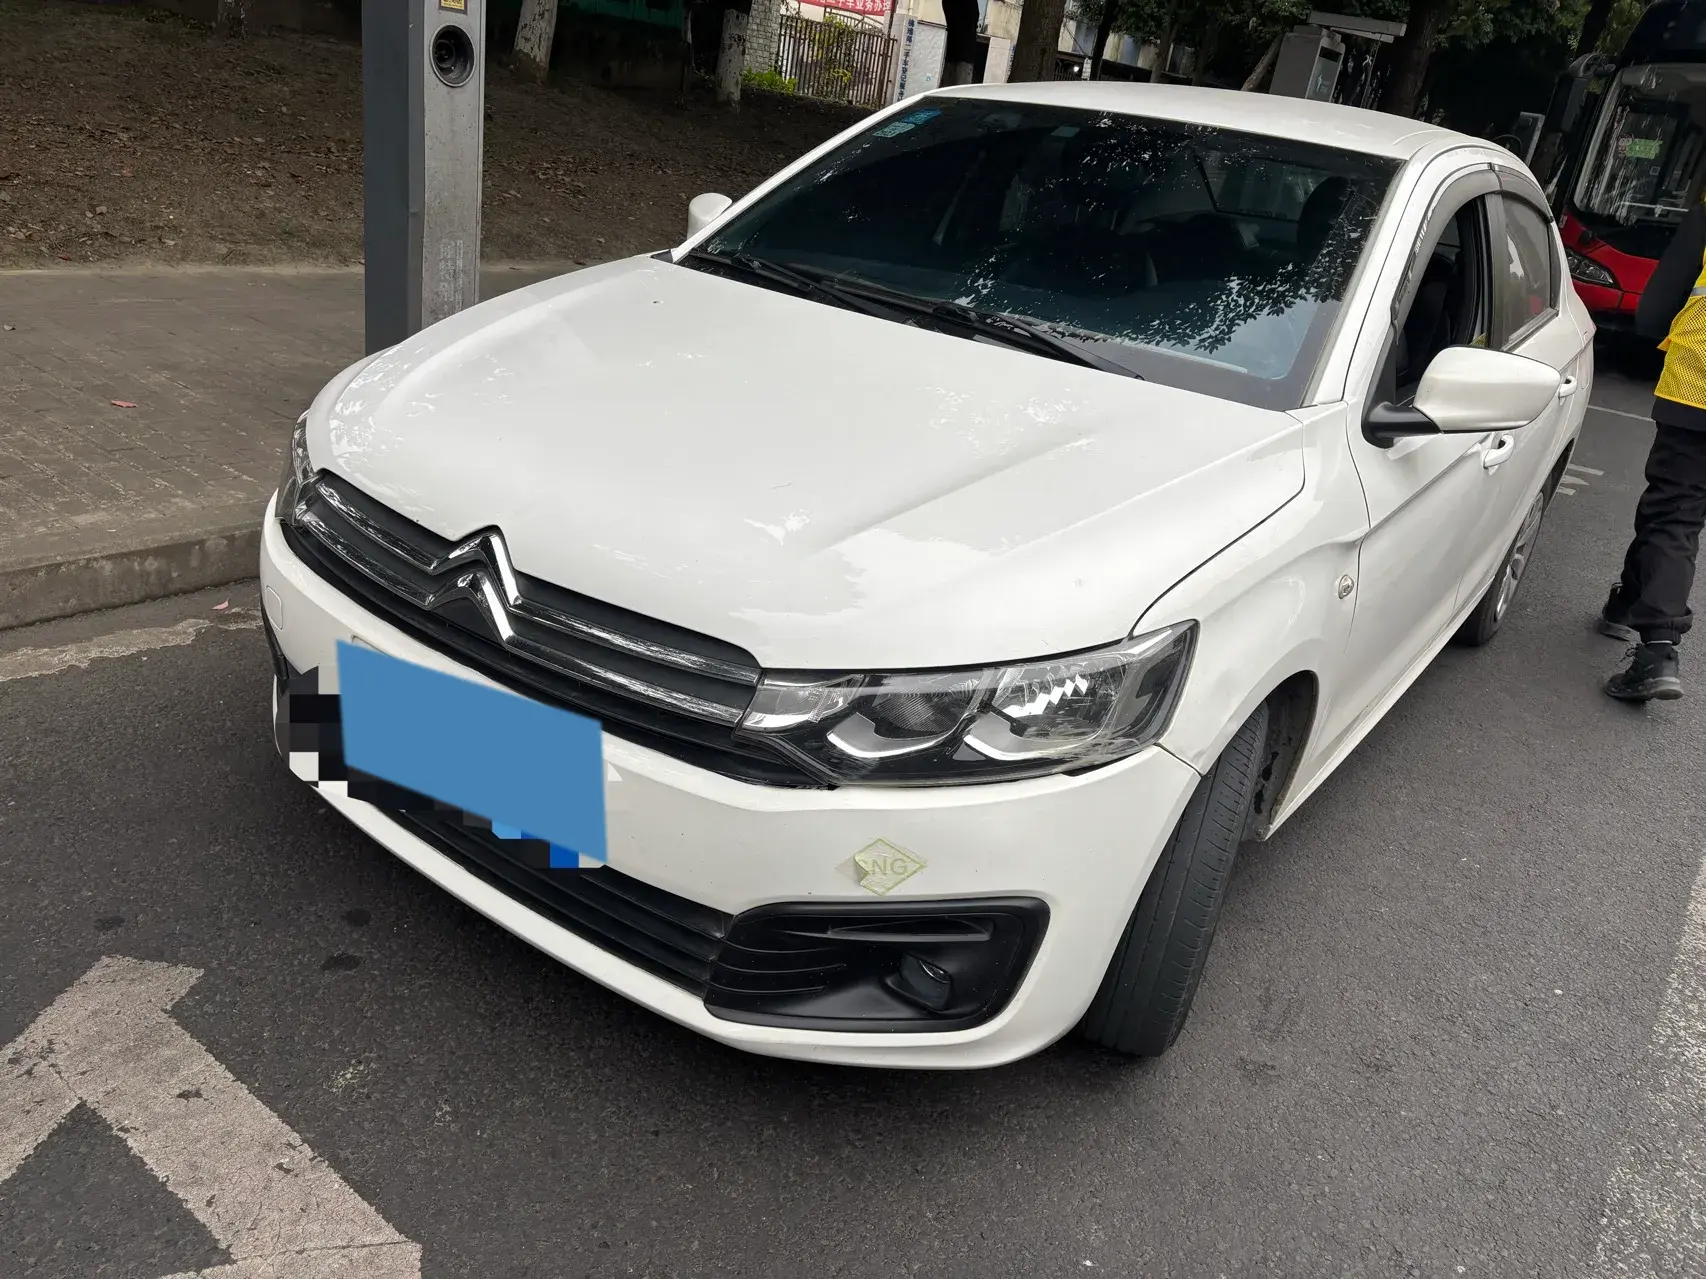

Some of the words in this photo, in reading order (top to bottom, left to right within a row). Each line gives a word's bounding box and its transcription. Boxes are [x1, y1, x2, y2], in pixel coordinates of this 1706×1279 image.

[817, 0, 892, 13] 手车业务办理
